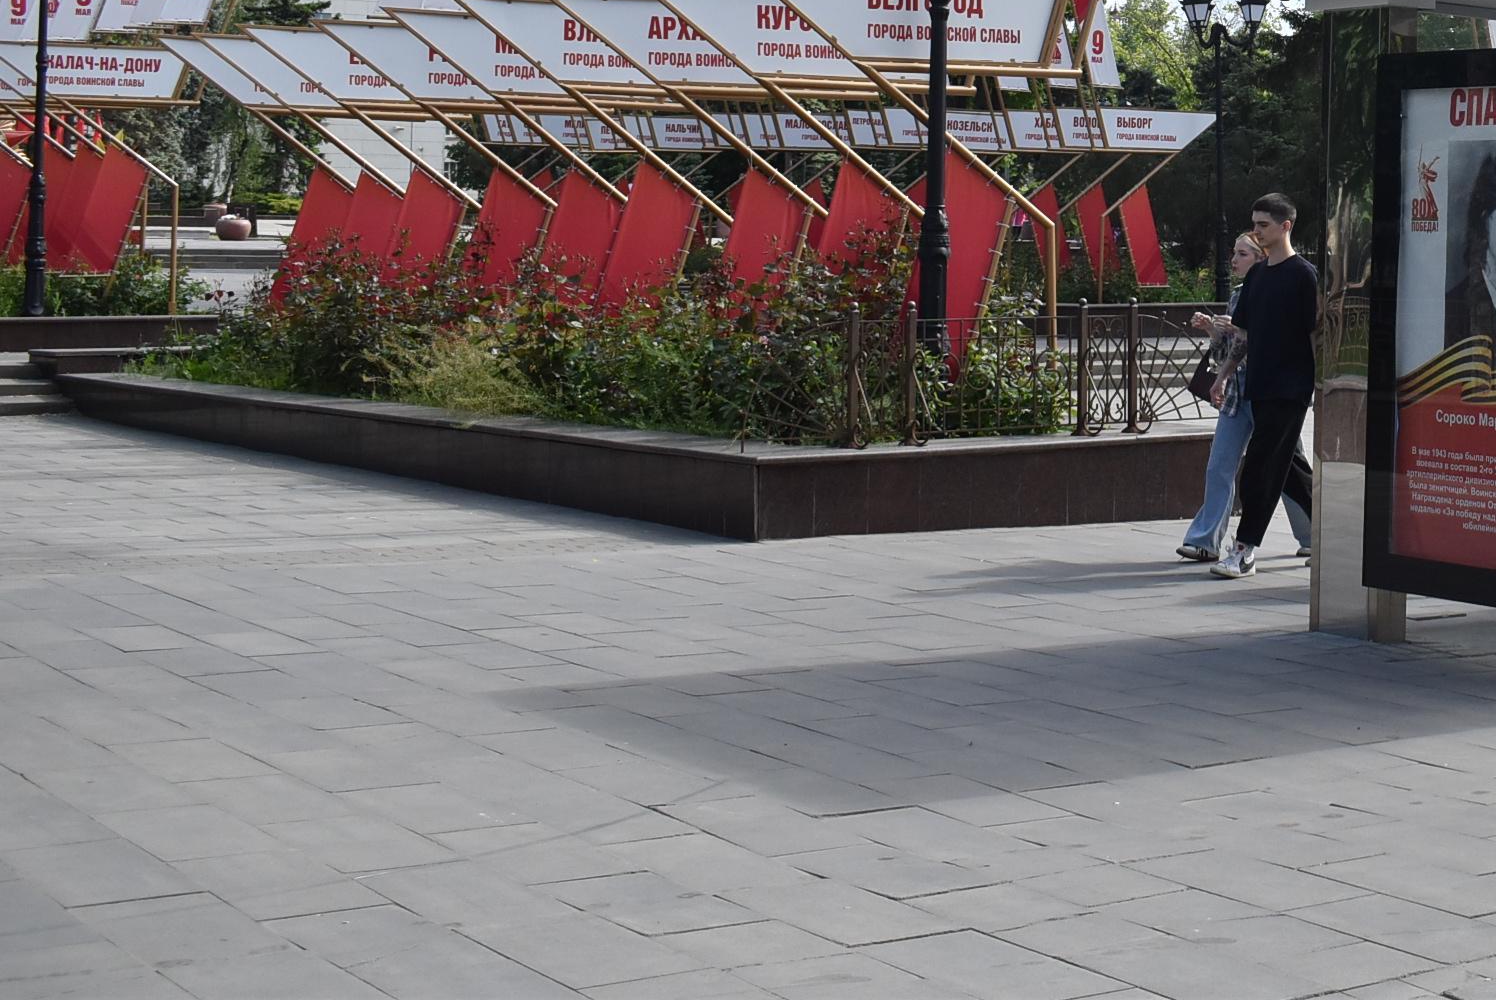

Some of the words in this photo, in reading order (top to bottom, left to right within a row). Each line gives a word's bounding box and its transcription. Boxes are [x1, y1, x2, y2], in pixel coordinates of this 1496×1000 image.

[75, 8, 91, 16] МАЯ
[867, 23, 913, 42] ГОРОДА
[917, 25, 976, 42] ВОСКОЙ
[980, 28, 1021, 44] СЛАВЫ
[757, 42, 801, 59] ГОРОДА
[1092, 30, 1104, 55] 9
[563, 52, 605, 68] ГОРОДА
[648, 52, 692, 68] ГОРОДА
[428, 72, 468, 87] ГОРОДА
[495, 65, 535, 80] ГОРОДА
[349, 74, 387, 88] ГОРОДА
[947, 119, 993, 132] КОЗЕЛЬСК
[1117, 117, 1153, 129] ВЫБОРГ
[1412, 198, 1426, 219] 80
[1411, 221, 1439, 233] ПОБЕДА!
[1436, 409, 1476, 427] Сороко
[1411, 446, 1417, 455] В
[1465, 451, 1484, 462] была
